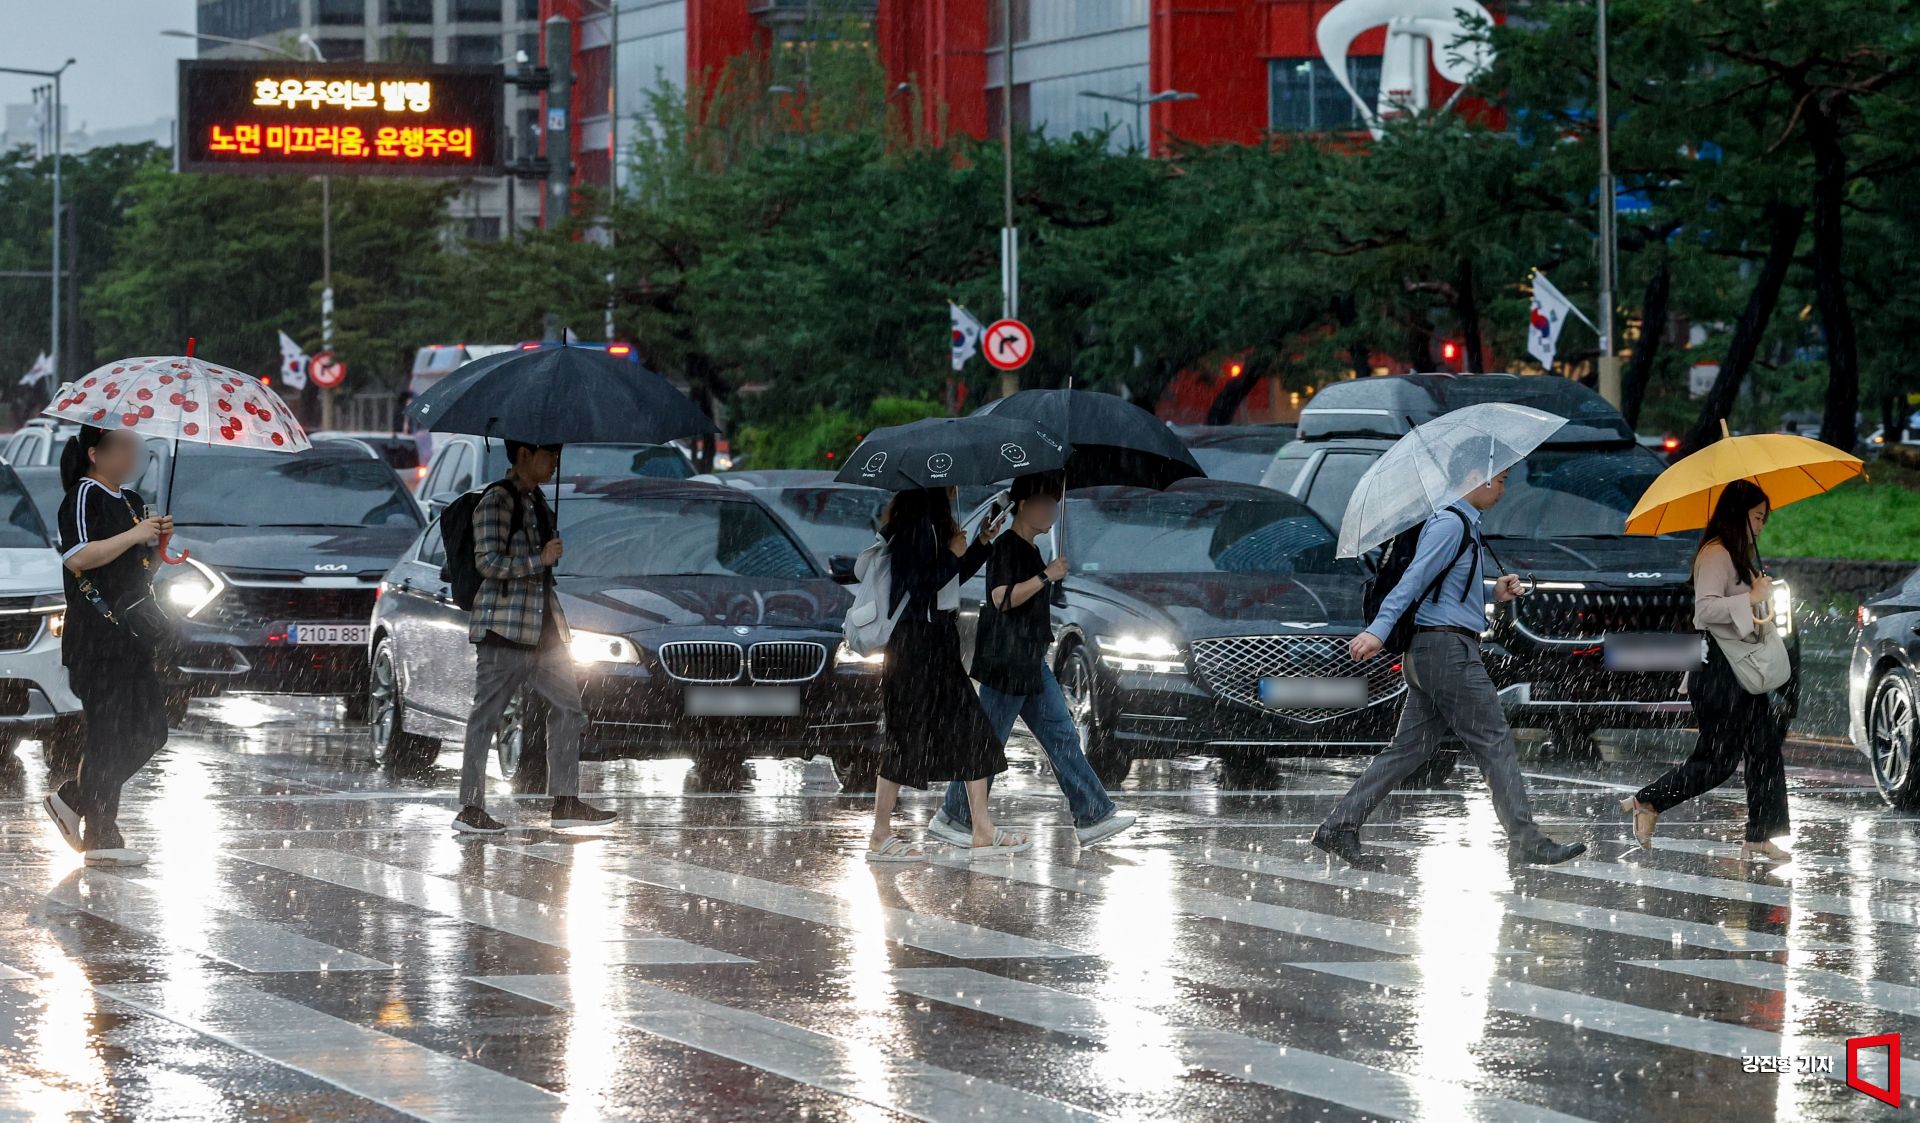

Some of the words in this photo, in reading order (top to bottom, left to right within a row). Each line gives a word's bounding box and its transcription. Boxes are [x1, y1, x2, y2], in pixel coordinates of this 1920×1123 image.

[253, 78, 377, 110] 호우주의보
[380, 79, 431, 112] 발령
[210, 124, 261, 155] 노면
[266, 124, 371, 157] 미끄러움,
[374, 126, 473, 158] 운행주의
[341, 627, 370, 642] 881
